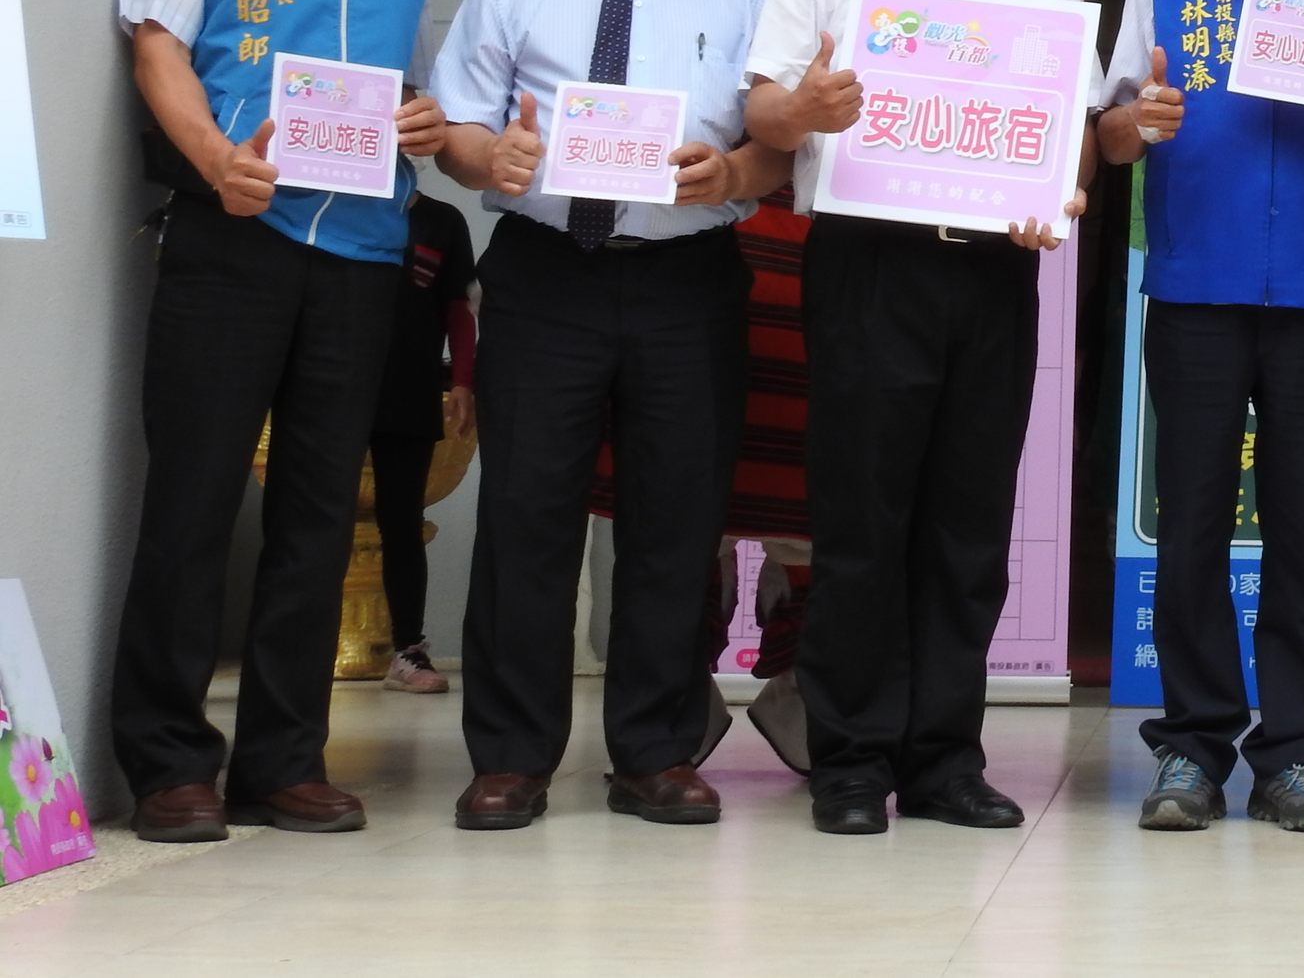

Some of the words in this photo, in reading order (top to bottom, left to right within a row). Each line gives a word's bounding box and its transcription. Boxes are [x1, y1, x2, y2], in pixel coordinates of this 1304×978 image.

[287, 116, 380, 157] 安心旅宿
[861, 88, 1049, 161] 安心旅宿
[565, 135, 662, 168] 安心旅宿
